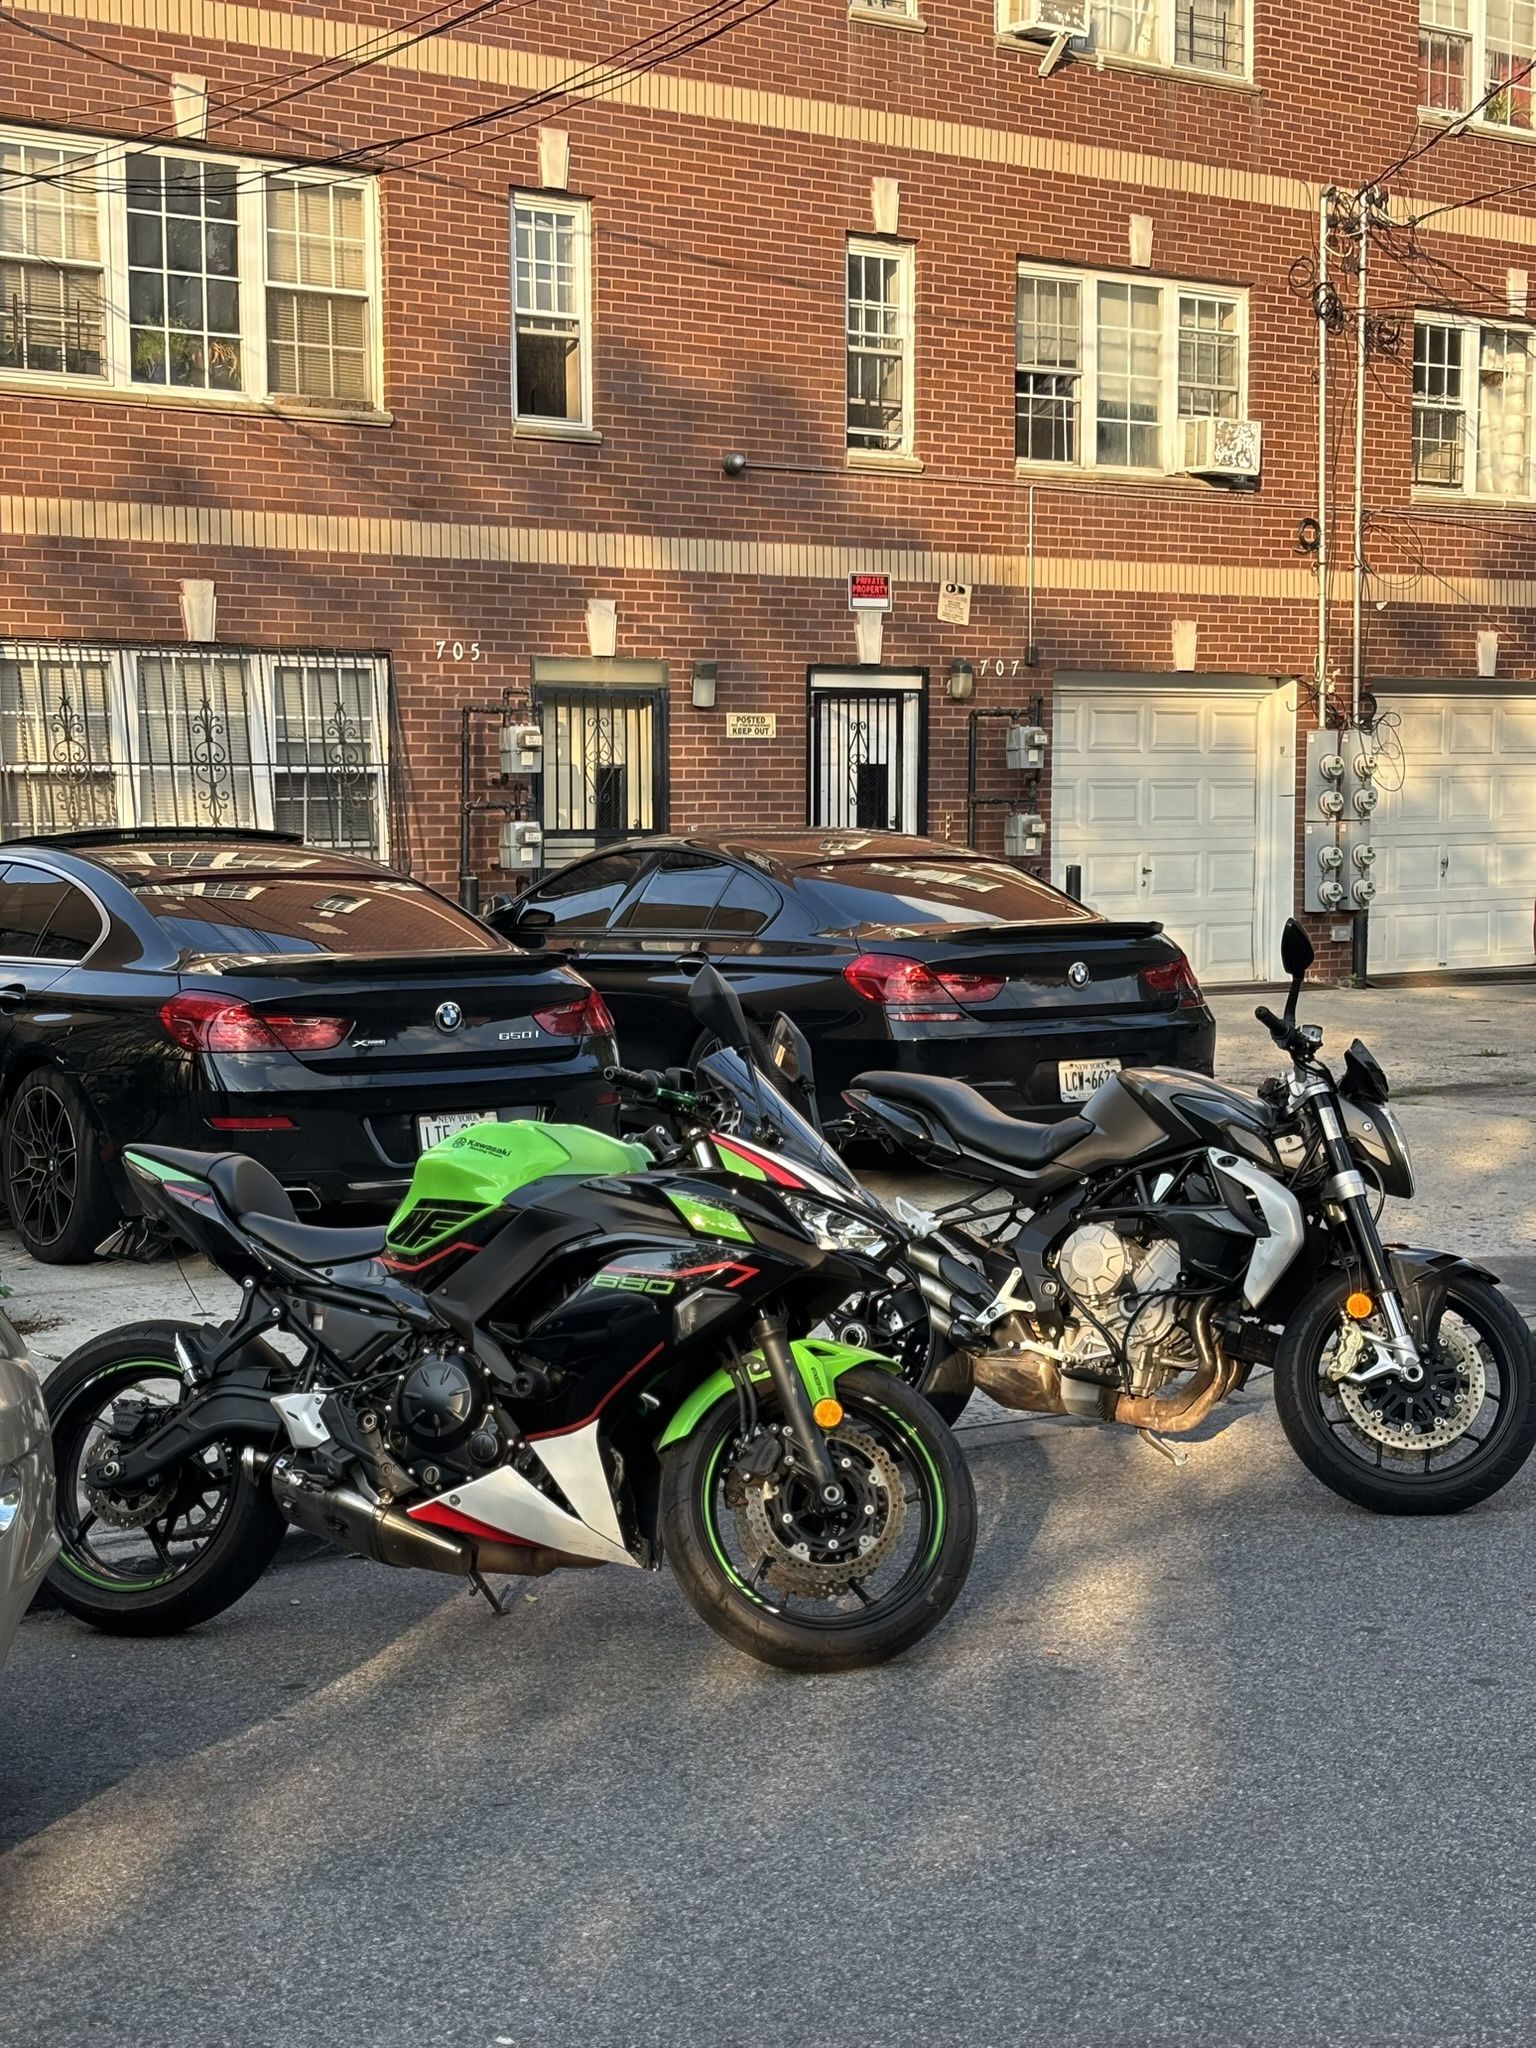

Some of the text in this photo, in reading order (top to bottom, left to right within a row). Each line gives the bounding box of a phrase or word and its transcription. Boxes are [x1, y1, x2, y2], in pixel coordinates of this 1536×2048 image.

[856, 576, 885, 585] PRIVATE
[852, 584, 888, 594] PROPERTY
[435, 640, 480, 662] 705
[980, 659, 1020, 677] 707
[736, 716, 766, 724] POSTED
[732, 727, 770, 735] KEEP OUT
[1074, 1063, 1089, 1071] NEW
[437, 1113, 480, 1124] NEW YORK
[467, 1139, 512, 1157] Kawasaki
[592, 1273, 676, 1295] 650
